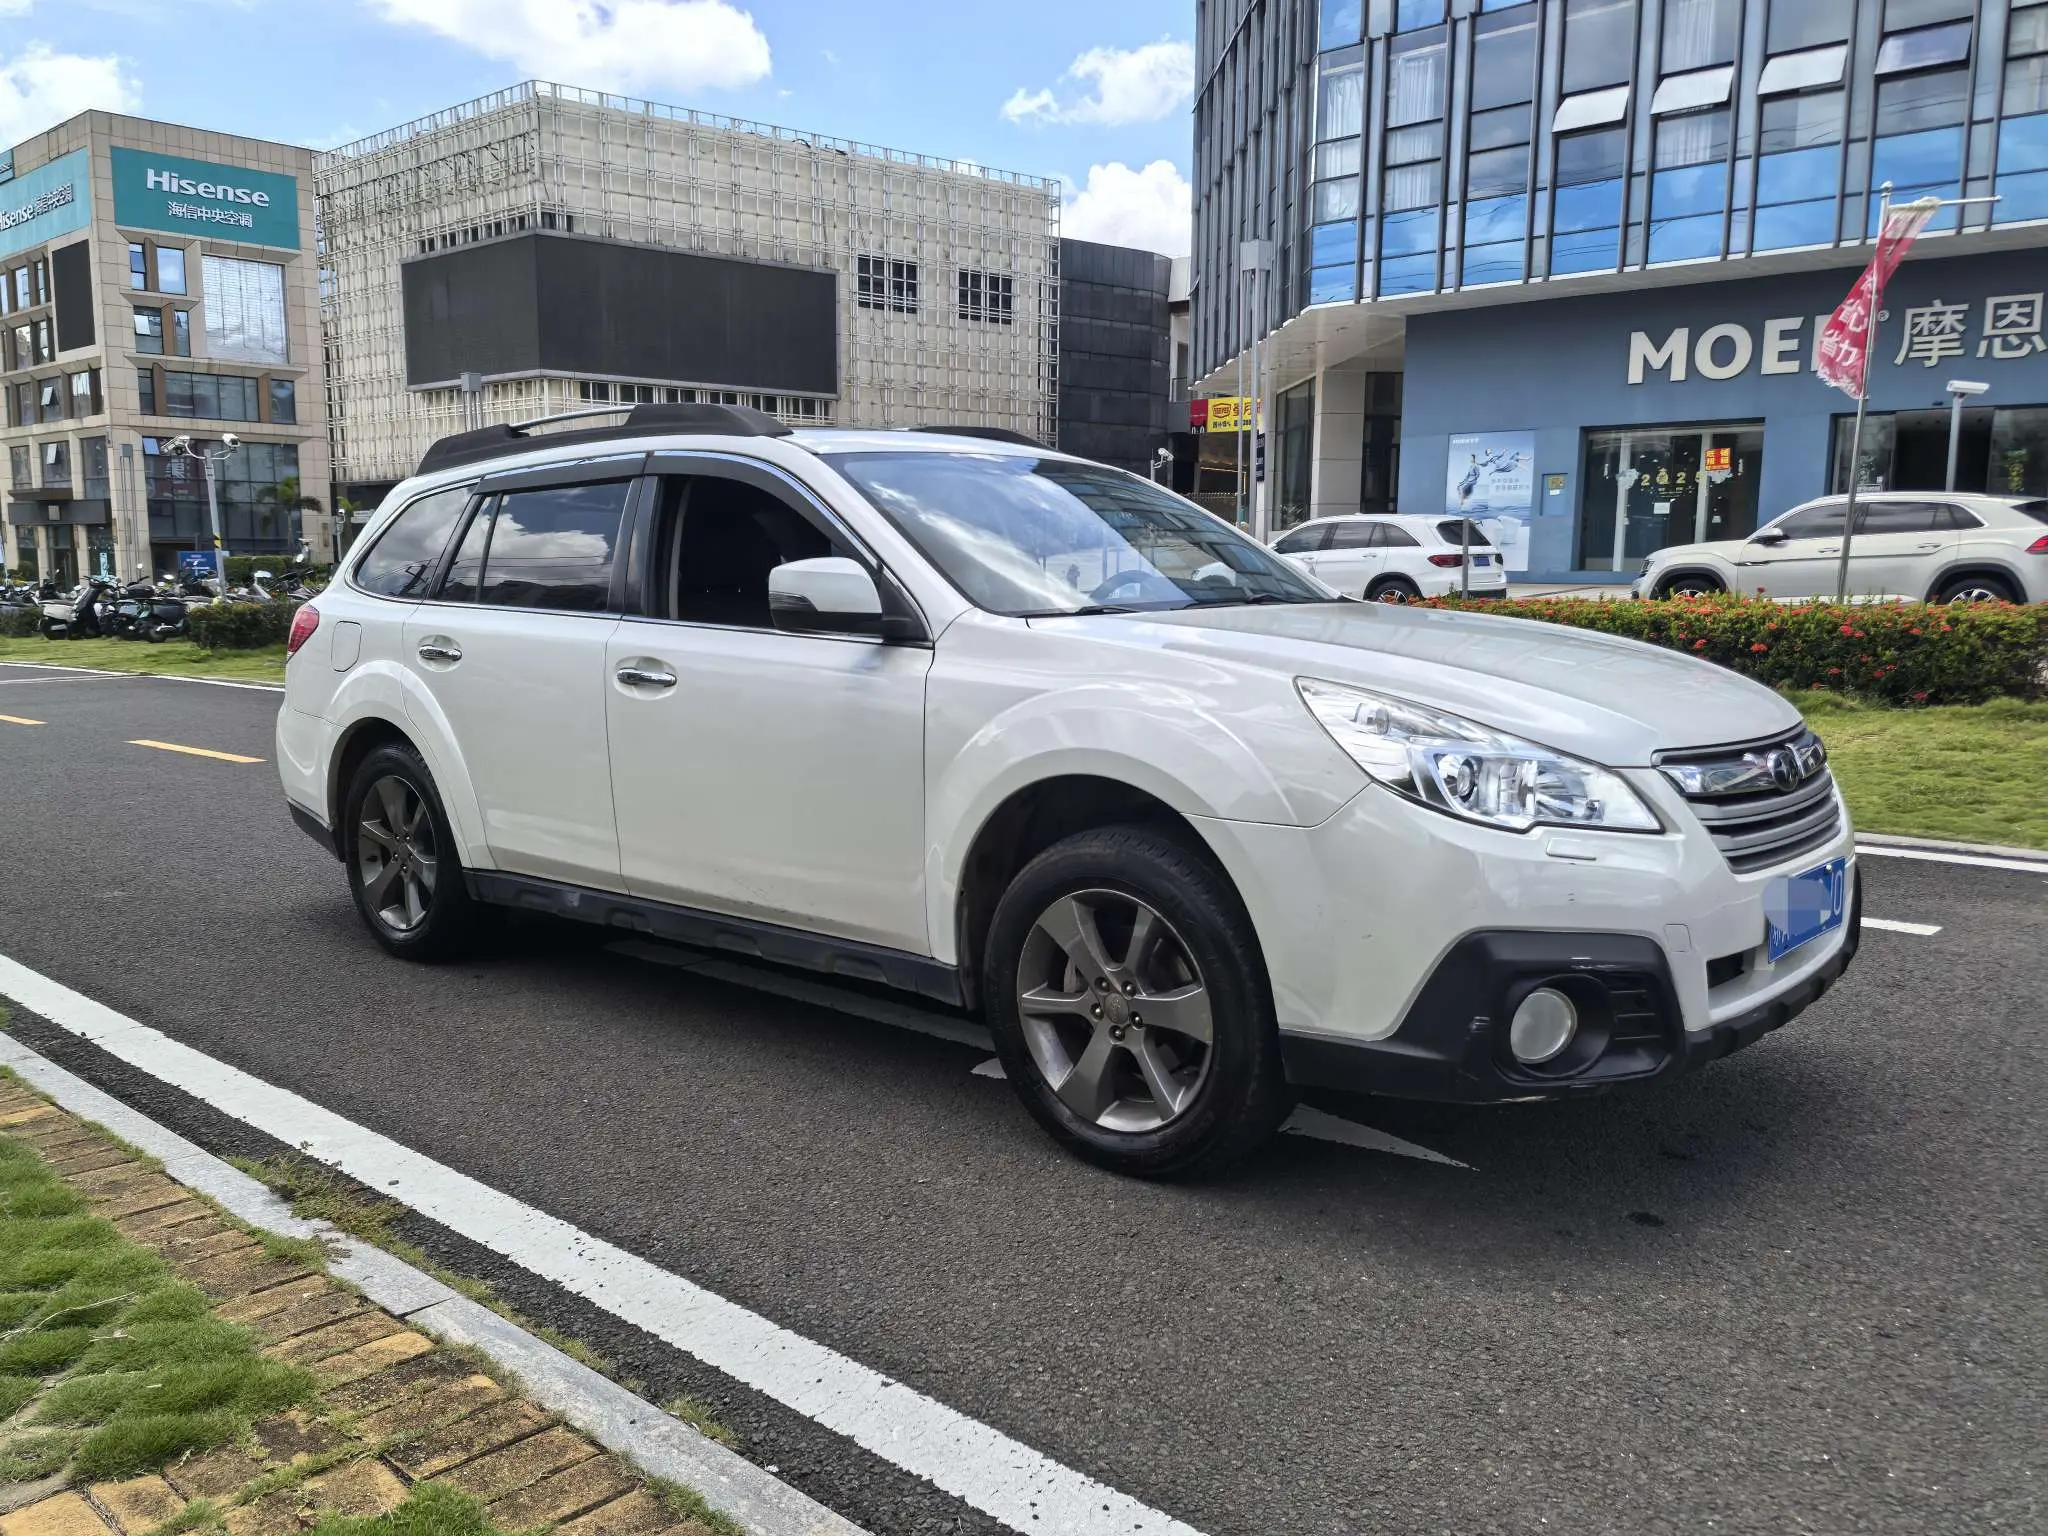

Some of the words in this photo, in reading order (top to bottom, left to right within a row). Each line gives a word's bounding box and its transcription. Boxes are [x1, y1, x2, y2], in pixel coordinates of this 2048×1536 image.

[146, 168, 270, 208] Hisense
[167, 201, 253, 228] 海信中央空调
[1820, 329, 1858, 366] 省力
[1893, 292, 2048, 368] 摩恩
